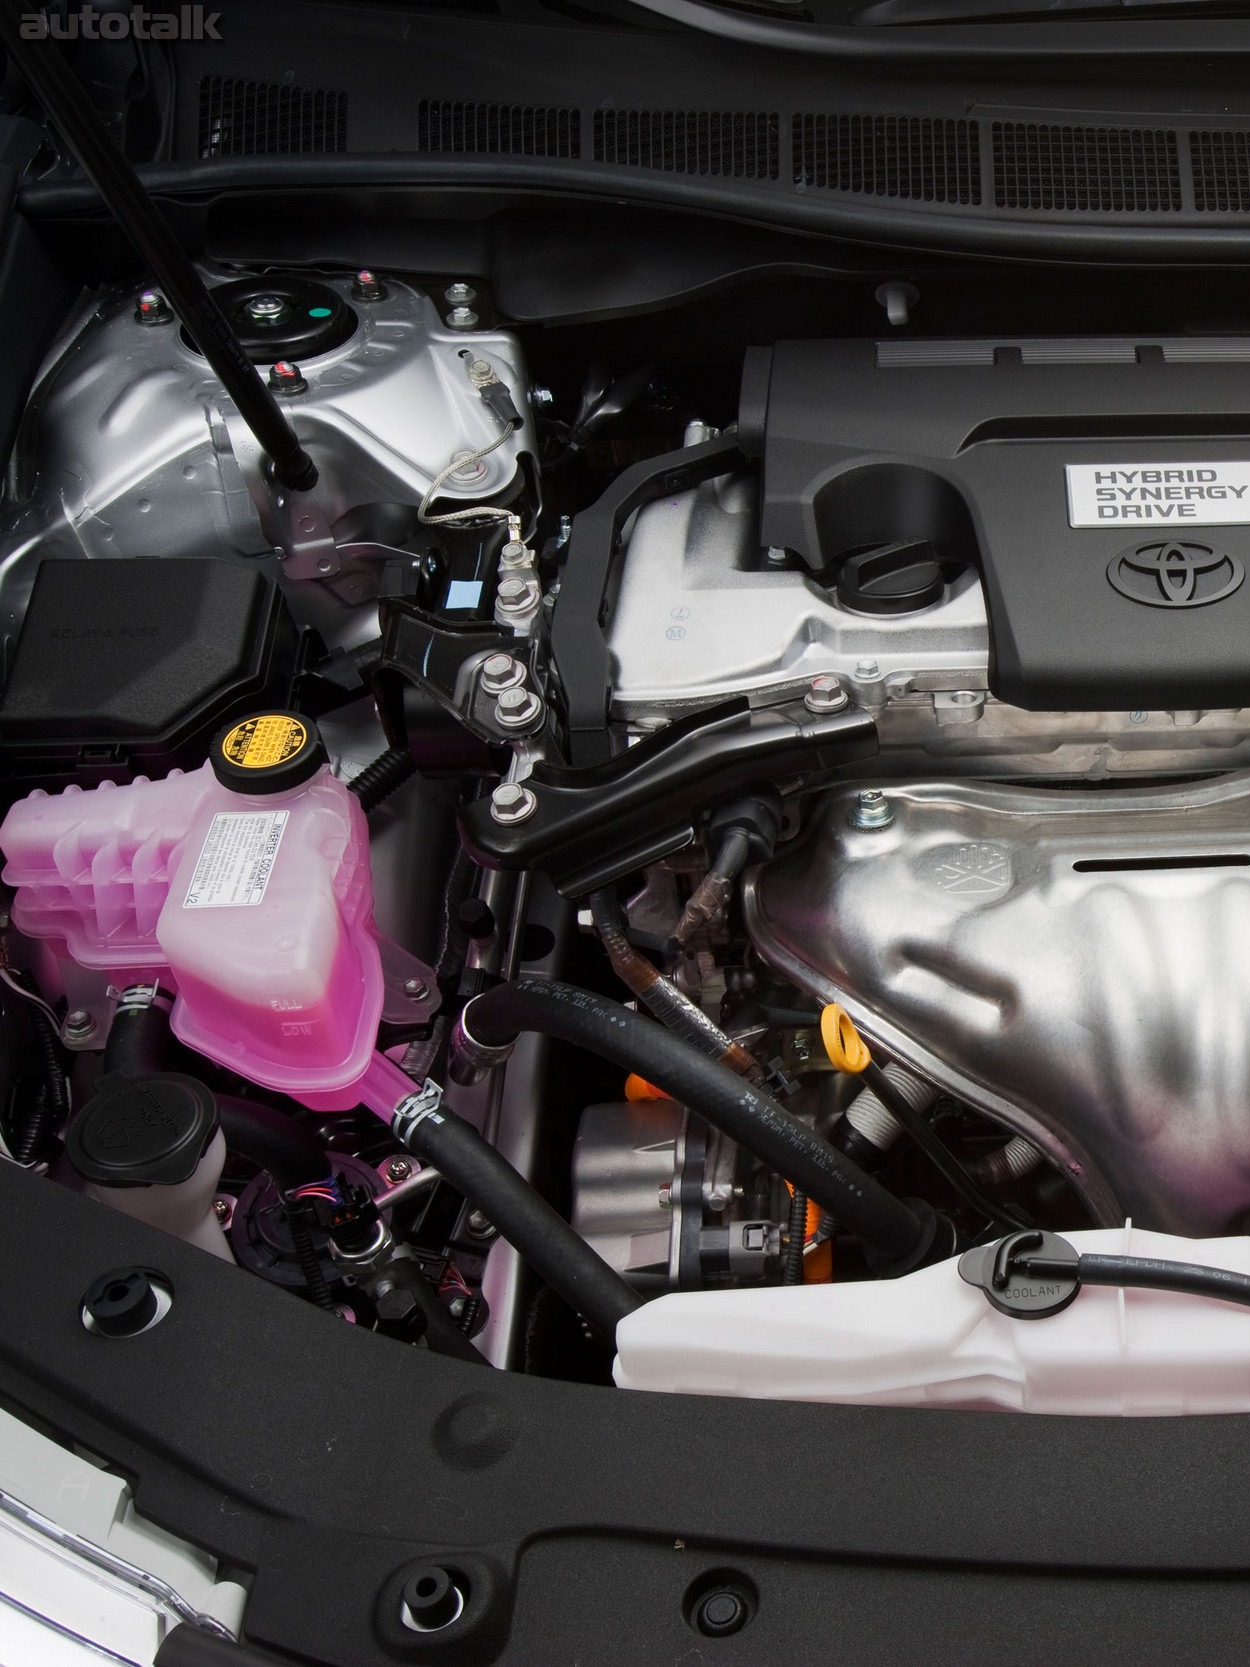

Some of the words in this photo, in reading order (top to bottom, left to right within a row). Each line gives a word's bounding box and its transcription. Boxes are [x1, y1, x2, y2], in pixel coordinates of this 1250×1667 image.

[1094, 469, 1217, 484] HYBRID
[1096, 485, 1249, 501] SYNERGY
[1097, 503, 1197, 518] DRIVE
[236, 732, 253, 760] ATTENTION
[281, 731, 296, 757] CAUTION
[263, 824, 282, 856] INVERTER
[254, 858, 271, 890] COOLANT
[186, 892, 200, 904] V2
[270, 999, 303, 1010] FULL
[281, 1025, 312, 1036] LOW
[1213, 1271, 1231, 1281] 06
[1004, 1285, 1062, 1300] COOLANT
